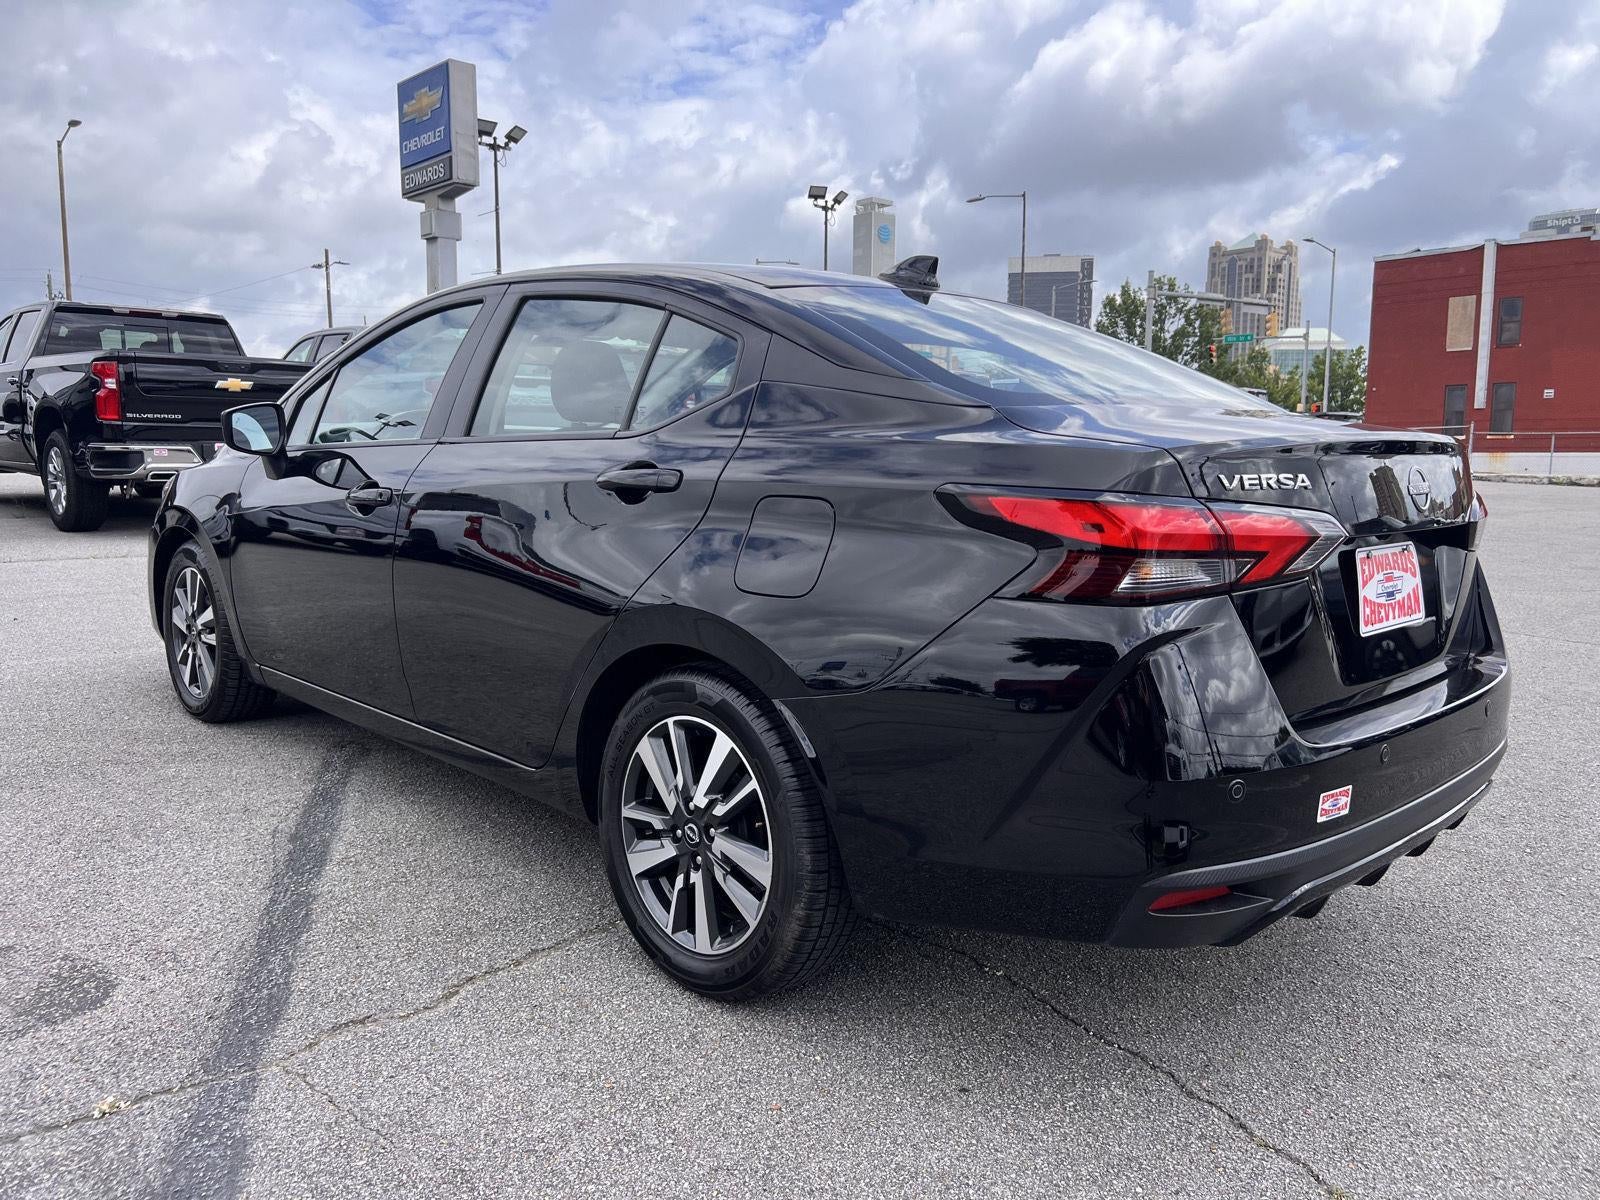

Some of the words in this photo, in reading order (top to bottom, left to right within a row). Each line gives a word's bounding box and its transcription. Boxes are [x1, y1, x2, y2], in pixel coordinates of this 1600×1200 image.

[402, 126, 445, 154] CHEVROLET
[404, 162, 445, 189] EDWARDS
[1218, 473, 1313, 491] VERSA
[1359, 550, 1417, 590] EDWARDS
[1362, 583, 1421, 627] CHEVYMAN
